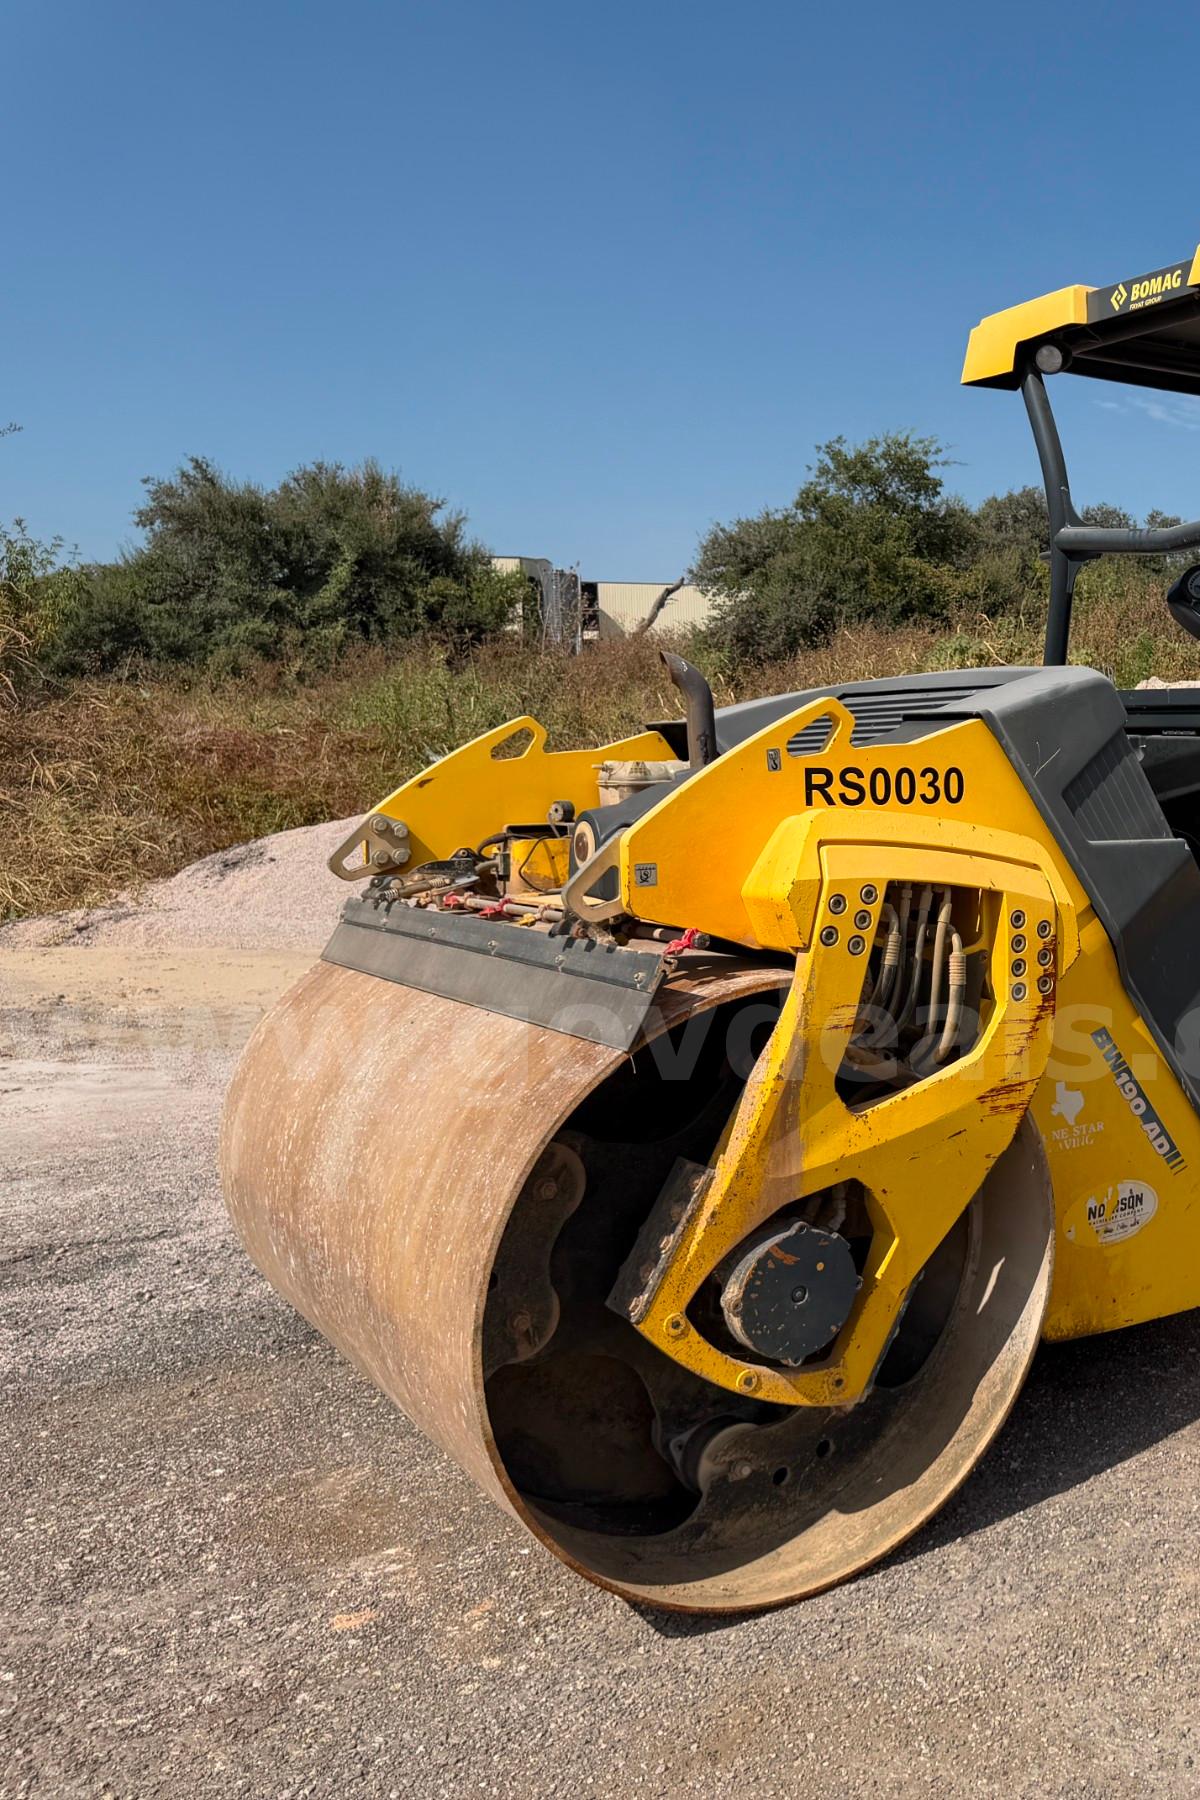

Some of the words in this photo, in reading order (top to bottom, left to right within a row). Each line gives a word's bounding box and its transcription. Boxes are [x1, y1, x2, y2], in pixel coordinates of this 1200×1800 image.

[1130, 269, 1182, 302] BOMAG
[804, 766, 965, 807] RS0030
[1072, 1121, 1105, 1137] STAR
[1141, 1121, 1170, 1156] AD
